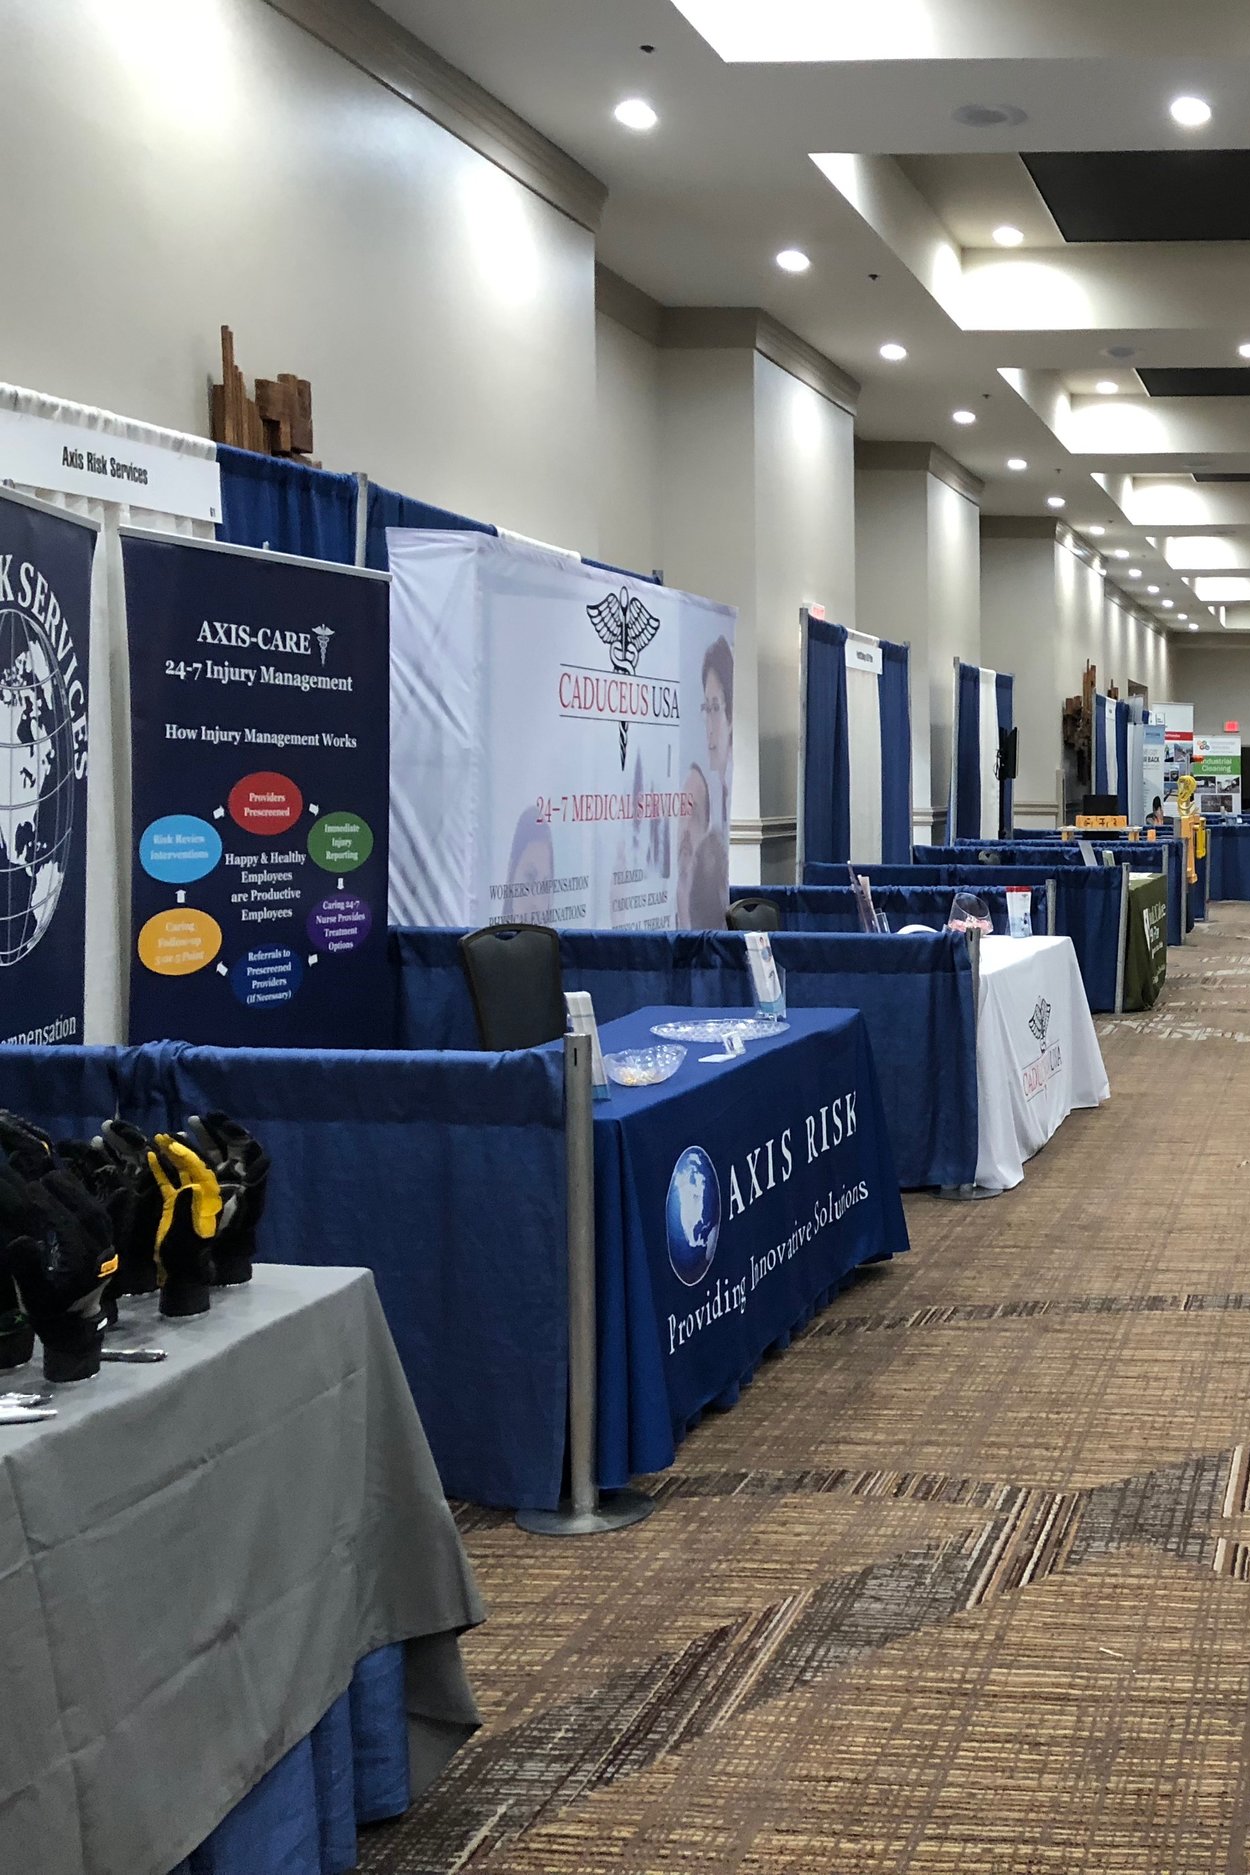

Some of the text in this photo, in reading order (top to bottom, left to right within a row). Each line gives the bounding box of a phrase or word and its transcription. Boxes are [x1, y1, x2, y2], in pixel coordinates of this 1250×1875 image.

[62, 446, 149, 486] Axis Risk Services
[197, 620, 312, 655] AXIS-CARE
[18, 562, 88, 780] SERVICES
[165, 659, 353, 692] 24-7 Injury Management
[559, 673, 680, 719] CADUCEUS USA
[165, 723, 357, 748] How Injury Management Works
[1202, 765, 1231, 773] Cleaning
[249, 792, 286, 802] Providers
[244, 807, 290, 817] Prescreened
[536, 792, 694, 824] 24-7 MEDICAL SERVICES
[325, 823, 360, 833] Immediate
[332, 837, 353, 849] Injury
[225, 851, 307, 868] Happy & Healthy
[326, 850, 359, 862] Reporting
[241, 869, 293, 885] Employees
[613, 869, 644, 885] TELEMED
[231, 887, 301, 902] are Productive
[489, 876, 589, 900] WORKERS COMPENSATION
[322, 900, 360, 910] Caring 24-7
[613, 890, 668, 912] CADUCEUS EXAMS
[241, 907, 293, 922] Employees
[316, 911, 366, 924] Nurse Provides
[531, 904, 587, 925] EXAMINATIONS
[644, 915, 671, 931] THERAPY
[324, 927, 358, 937] Treatment
[328, 940, 354, 952] Options
[248, 949, 291, 961] Referrals to
[247, 961, 292, 976] Prescreened
[252, 977, 287, 989] Providers
[256, 990, 292, 1002] Necessary)
[729, 1090, 858, 1221] AXIS RISK
[667, 1180, 869, 1355] Providing Innovative Solutions
